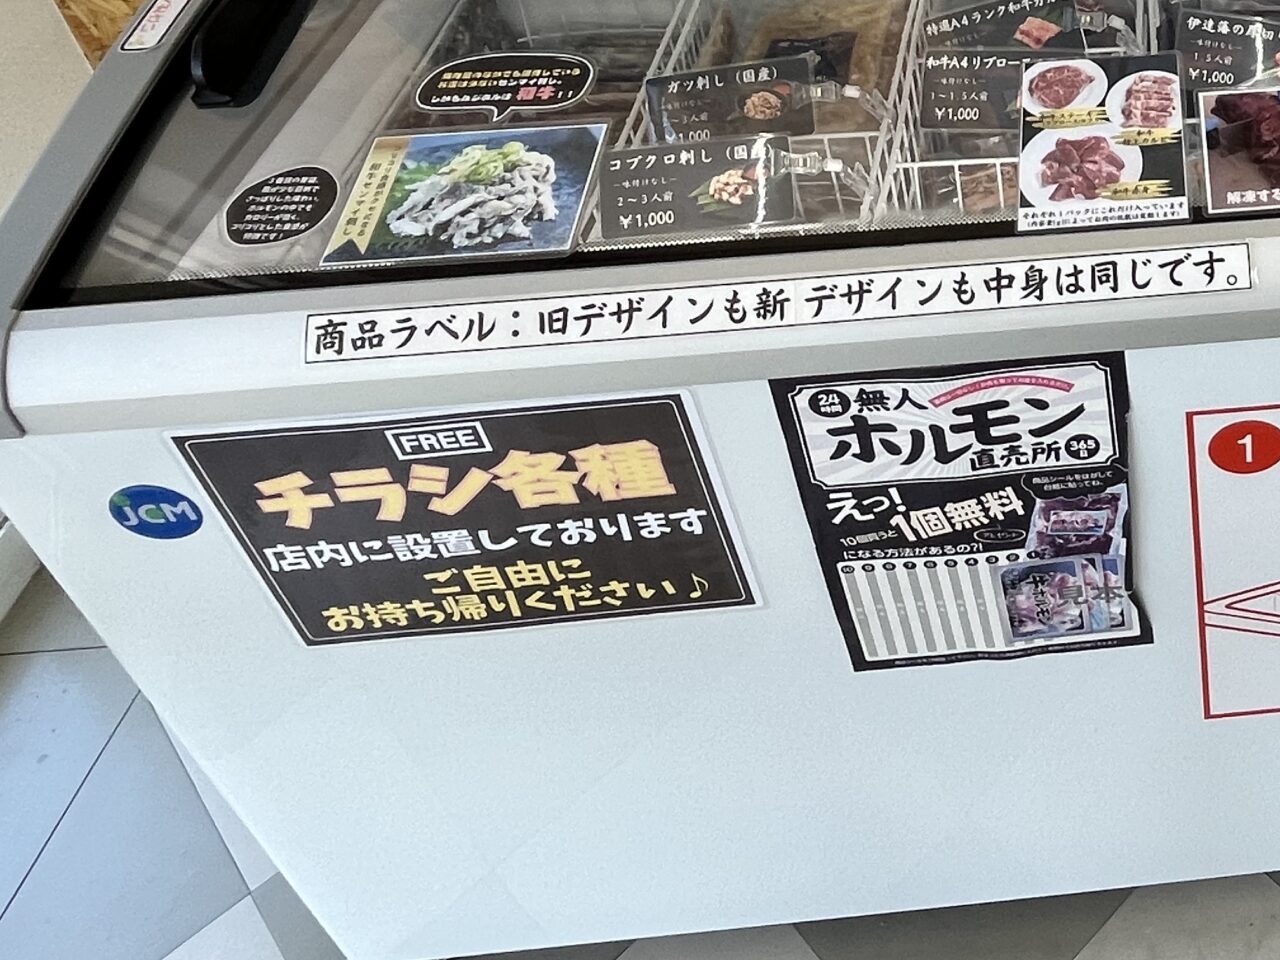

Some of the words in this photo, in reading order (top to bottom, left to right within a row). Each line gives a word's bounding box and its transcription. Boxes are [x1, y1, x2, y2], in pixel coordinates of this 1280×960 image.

[926, 54, 1031, 71] 和牛A4リブロー
[1188, 68, 1235, 85] ¥1,000
[935, 107, 980, 122] ¥1,000
[619, 210, 675, 230] ¥1,000
[817, 393, 841, 406] 24
[853, 387, 928, 413] 無人
[399, 428, 480, 455] FREE
[826, 397, 1086, 467] ホルモン
[1069, 439, 1097, 451] 365
[968, 440, 1062, 472] 直売所
[1239, 434, 1254, 462] 1
[254, 439, 676, 531] チラシ各種
[122, 499, 196, 527] JCM
[889, 486, 1025, 542] 1個無料
[265, 506, 708, 574] 店内に設置しております
[423, 559, 592, 595] ご自由に
